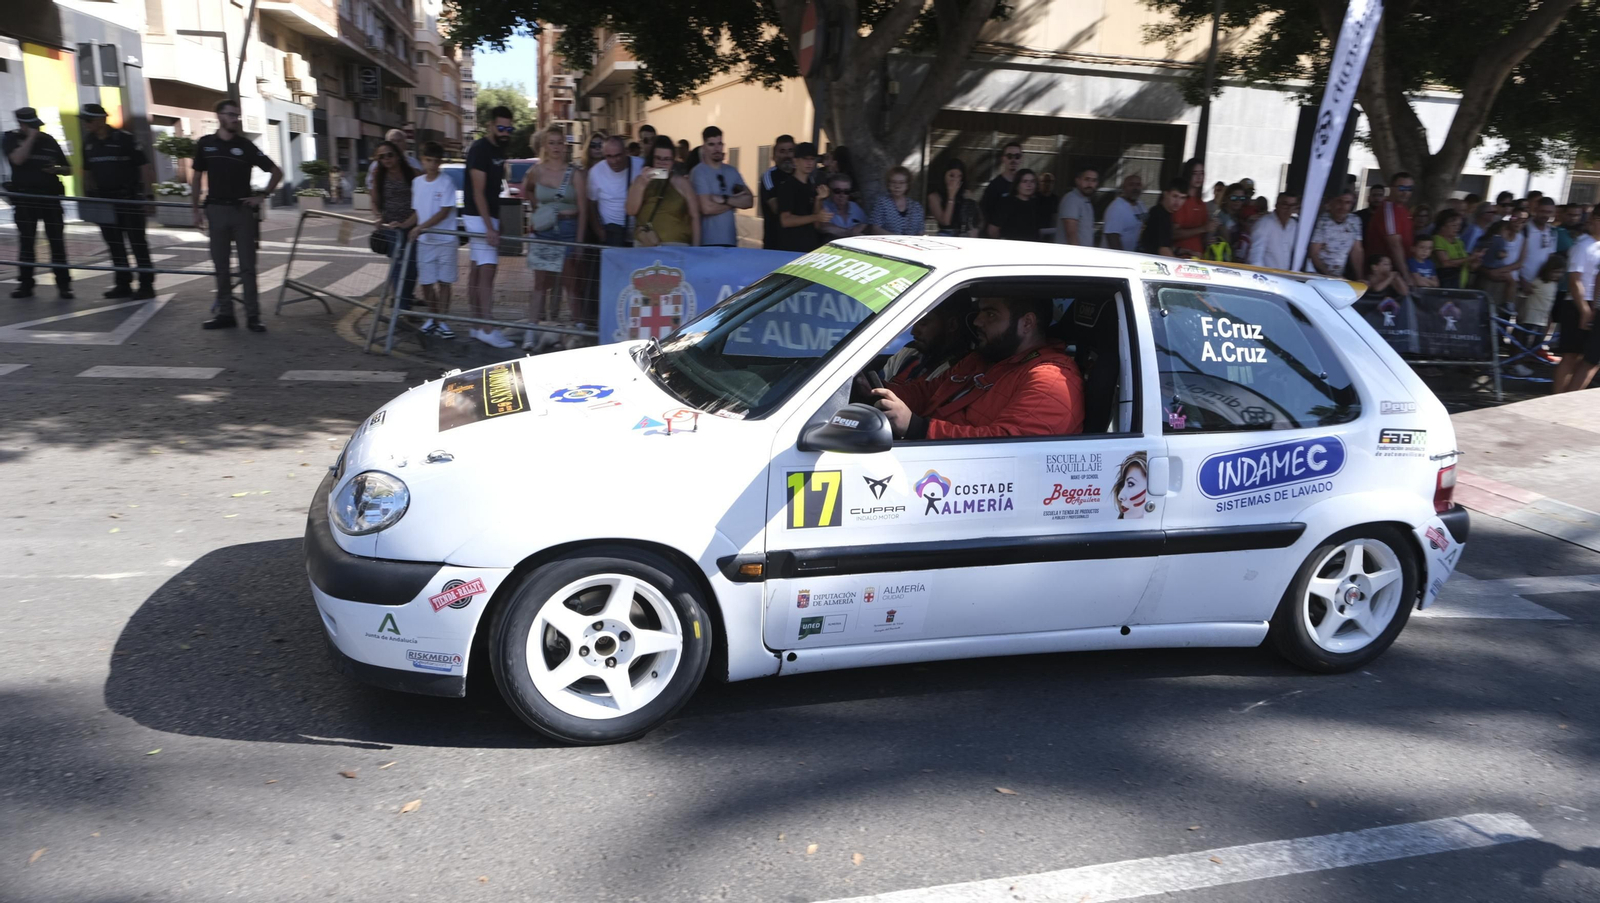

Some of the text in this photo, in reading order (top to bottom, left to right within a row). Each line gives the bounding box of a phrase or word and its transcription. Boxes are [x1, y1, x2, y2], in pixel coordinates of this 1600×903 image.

[1200, 316, 1264, 340] F.Cruz
[1201, 341, 1268, 363] A.Cruz
[1046, 453, 1102, 464] ESCUELA DE
[1046, 463, 1102, 474] MAQUILLAJE
[1217, 444, 1329, 491] INDAMEC
[954, 482, 1014, 496] COSTA DE
[1043, 483, 1101, 506] Begoña
[787, 471, 841, 528] 17
[1216, 481, 1333, 513] SISTEMAS DE LAVADO
[850, 505, 906, 515] CUPRA
[941, 494, 1014, 515] ALMERÍA
[883, 583, 926, 594] ALMERÍA
[813, 591, 857, 601] DIPUTACIÓN
[823, 598, 854, 606] ALMERÍA
[389, 636, 418, 644] Andalucía
